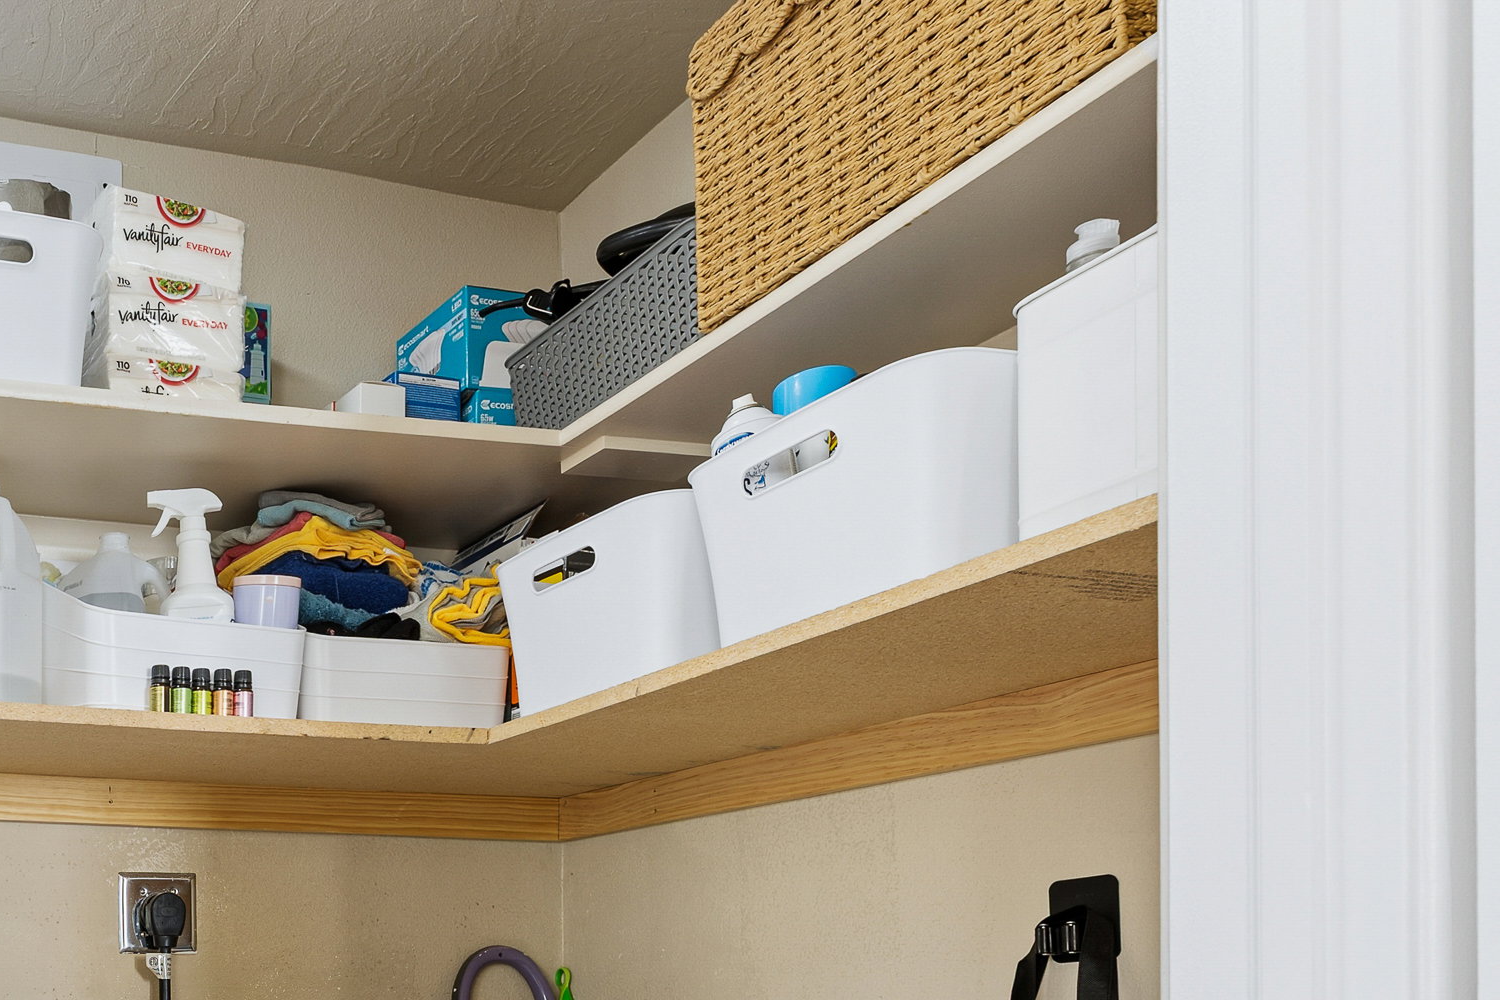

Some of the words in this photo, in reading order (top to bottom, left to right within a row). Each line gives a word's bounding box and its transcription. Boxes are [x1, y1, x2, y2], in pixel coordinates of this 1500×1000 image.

[124, 194, 138, 204] 110
[186, 241, 232, 259] EVERYDAY
[117, 276, 131, 287] 110
[451, 299, 463, 313] LED
[116, 360, 131, 371] 110
